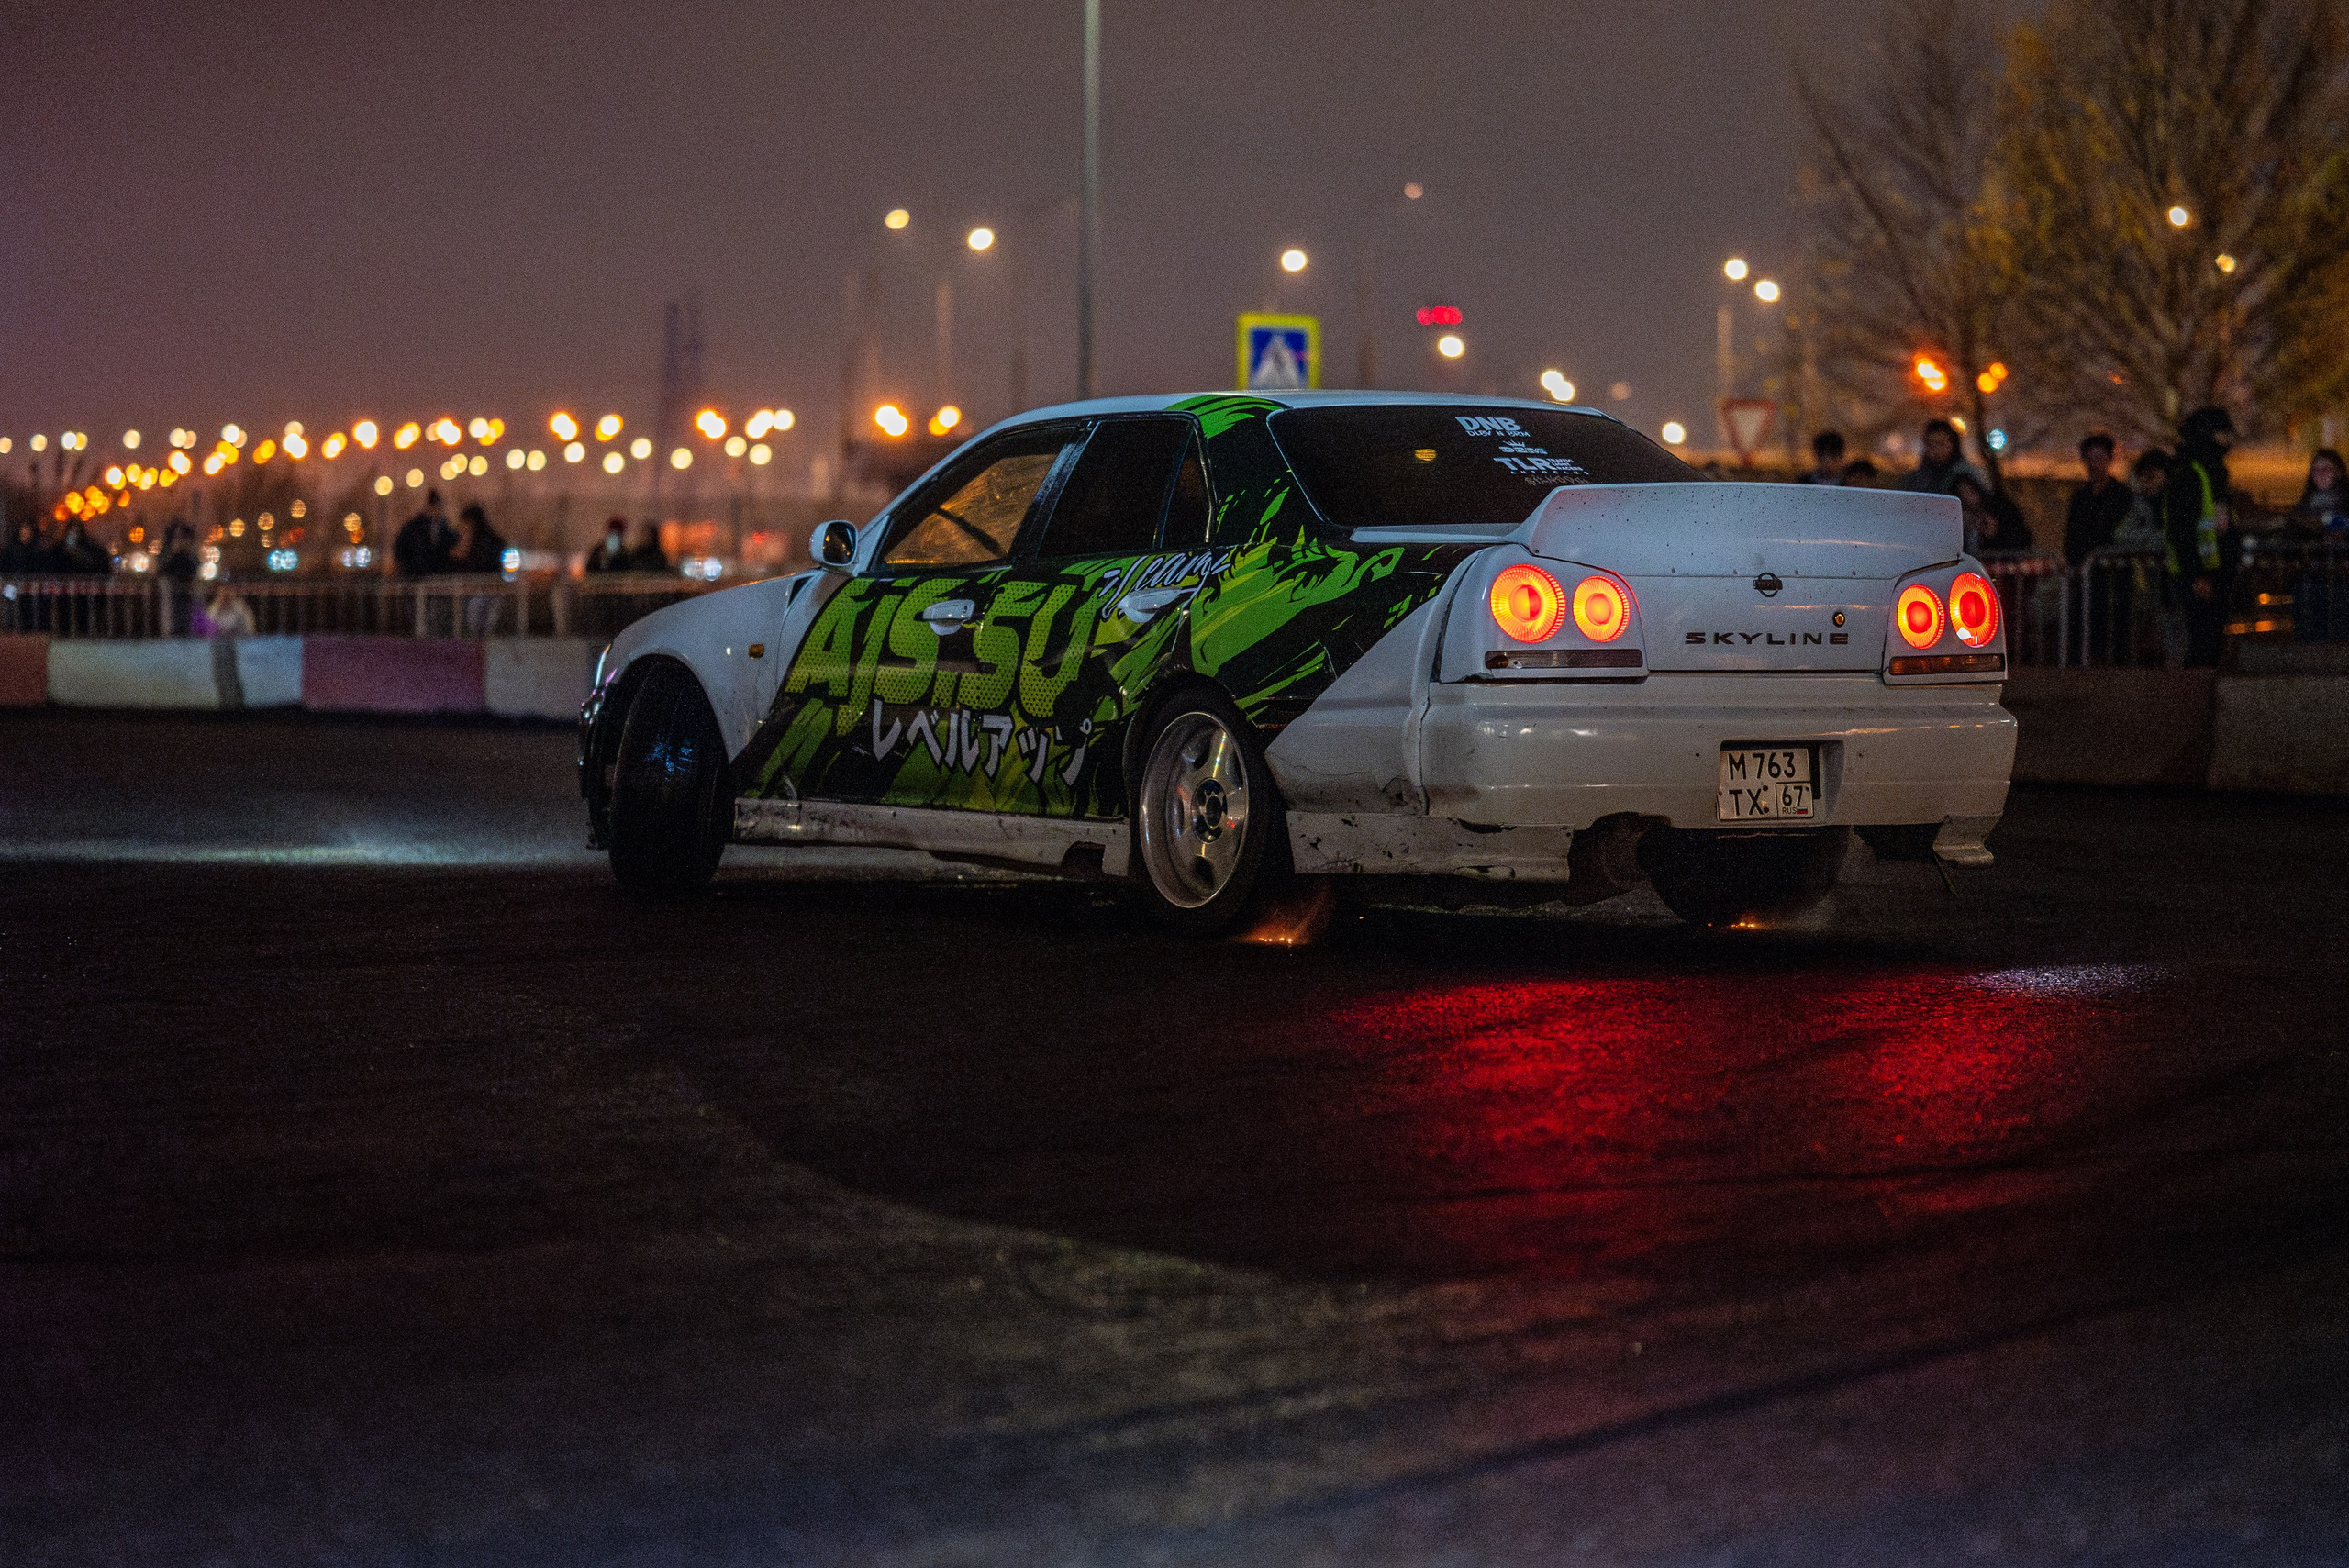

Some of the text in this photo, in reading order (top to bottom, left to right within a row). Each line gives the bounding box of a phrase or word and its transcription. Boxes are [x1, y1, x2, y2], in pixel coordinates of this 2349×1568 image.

[1454, 416, 1521, 431] DNB
[1493, 457, 1557, 471] TLR
[1685, 631, 1849, 646] SKYLINE
[873, 698, 1093, 787] レベルアップ
[1728, 752, 1796, 780] M 763
[1728, 785, 1803, 816] TX 67
[1782, 806, 1797, 815] RUS
